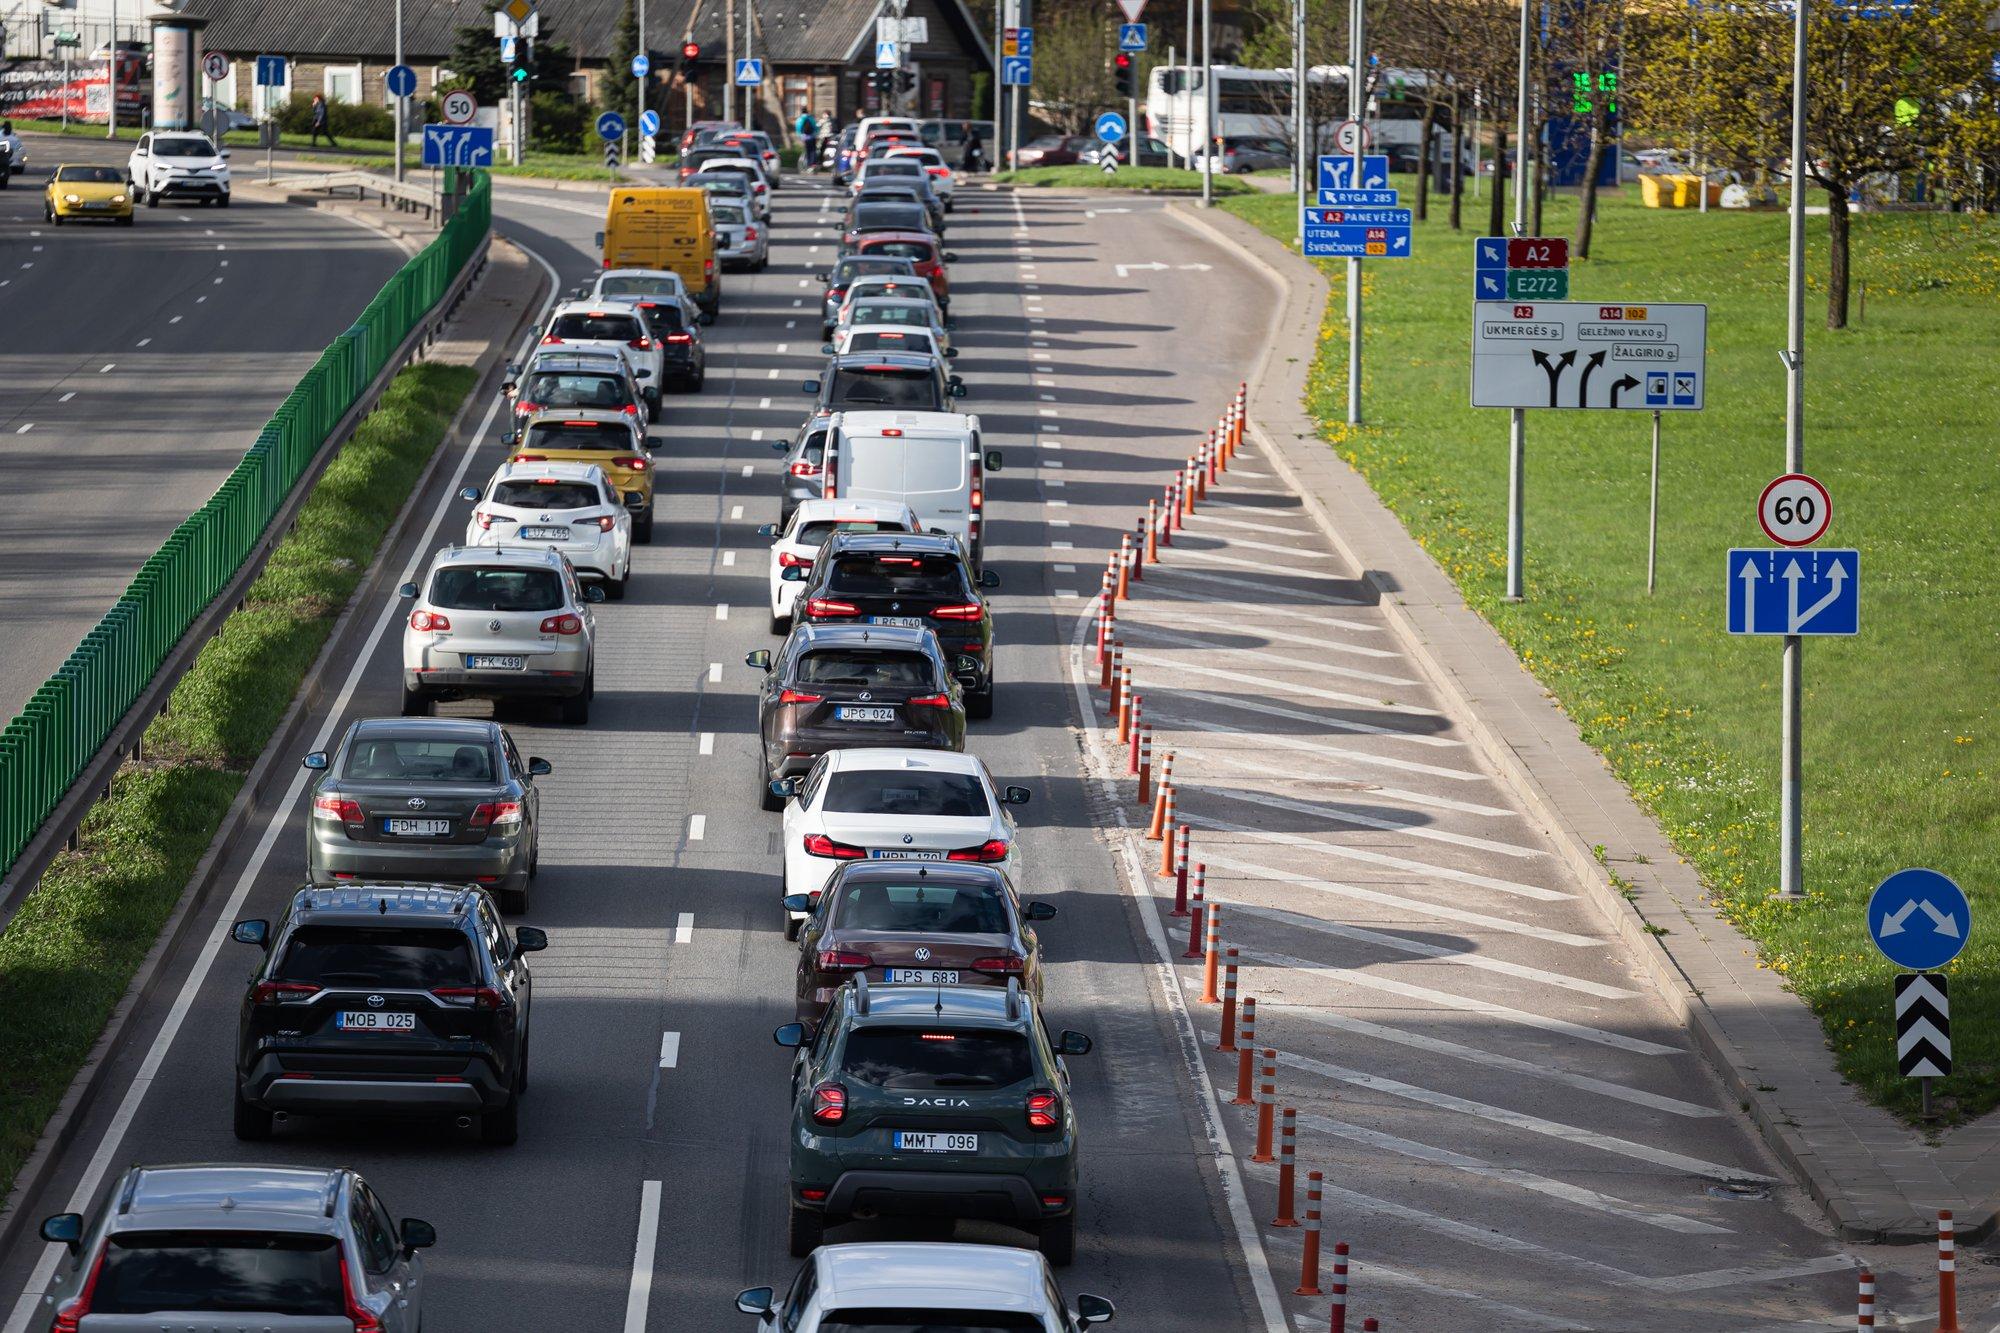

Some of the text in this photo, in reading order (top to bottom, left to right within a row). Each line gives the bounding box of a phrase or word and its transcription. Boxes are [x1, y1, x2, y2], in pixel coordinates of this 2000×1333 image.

[449, 101, 471, 115] 50
[1344, 131, 1353, 145] 5
[1338, 193, 1392, 203] RYGA 285
[1326, 213, 1341, 222] A2
[1307, 230, 1385, 239] UTENA A14
[1307, 241, 1365, 253] ŠVENČIONYS
[1526, 247, 1550, 261] A2
[1517, 278, 1557, 292] E272
[1516, 308, 1532, 317] A2
[1601, 309, 1646, 319] A14 102
[1486, 324, 1560, 338] UKMERGĖS g.
[1580, 327, 1665, 339] GELEŽINIO VILKO g.
[1615, 345, 1676, 360] ŽALGIRIO g.
[1775, 496, 1816, 526] 60
[902, 618, 921, 628] 040
[474, 655, 521, 667] FFK 499
[843, 708, 866, 719] JPG
[872, 709, 893, 719] 024
[391, 820, 448, 832] FDH 117
[893, 970, 923, 983] LPS
[931, 971, 957, 984] 683
[345, 1013, 377, 1028] MOB
[387, 1014, 412, 1029] 025
[904, 1097, 970, 1107] DACIA
[904, 1134, 937, 1148] MMT
[947, 1135, 975, 1149] 096
